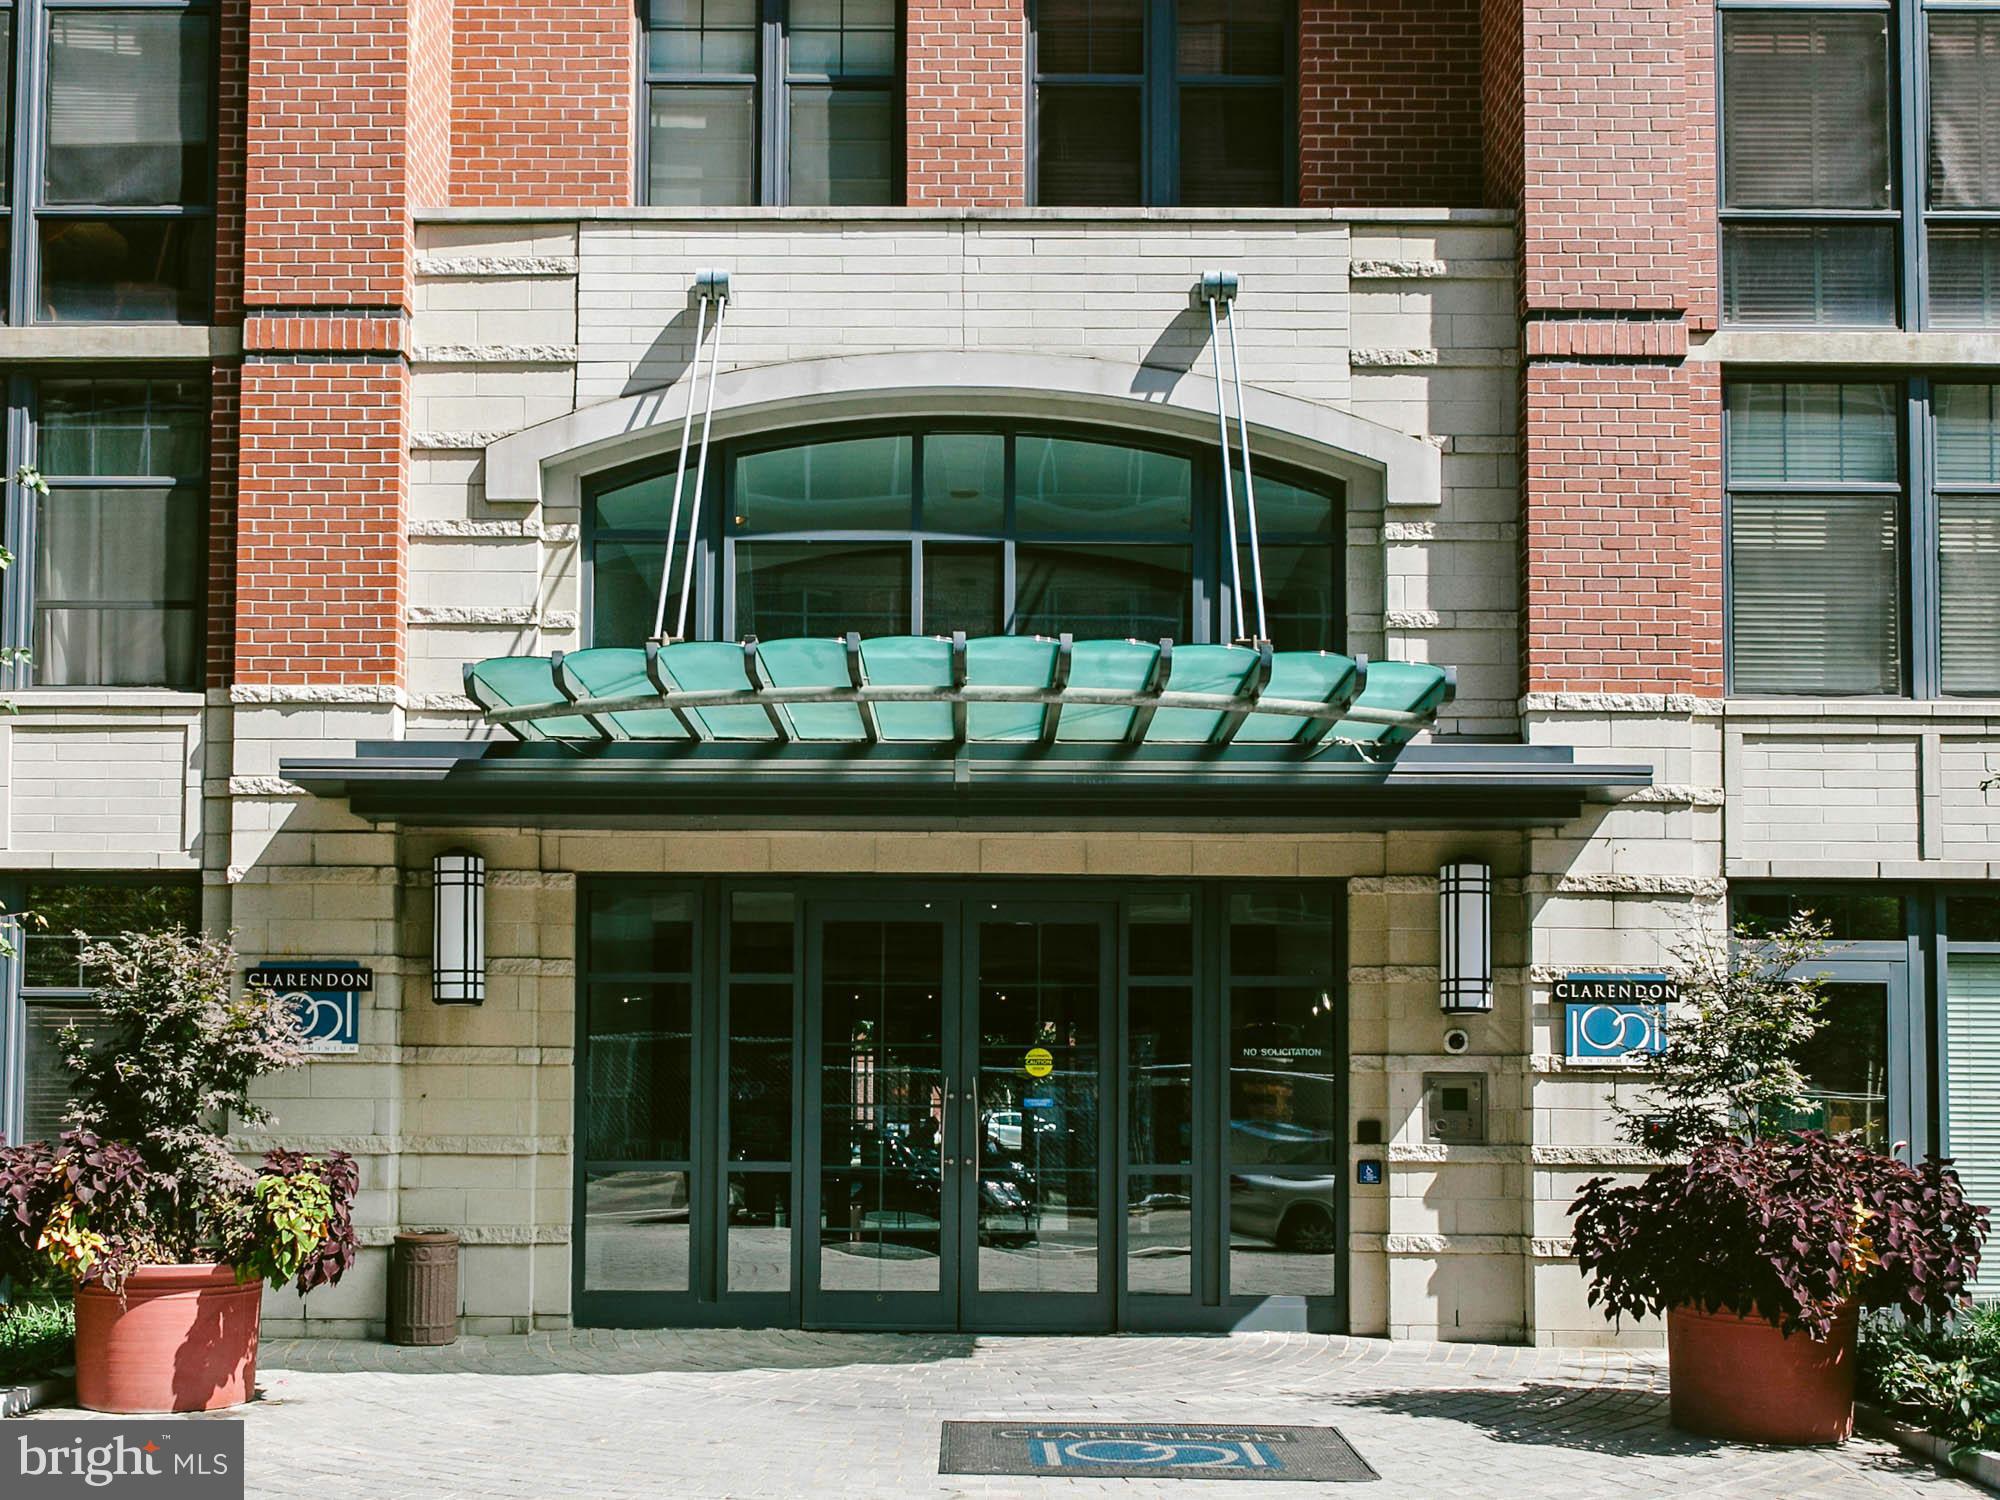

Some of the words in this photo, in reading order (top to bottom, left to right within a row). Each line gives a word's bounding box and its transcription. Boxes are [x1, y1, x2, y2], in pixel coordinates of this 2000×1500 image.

[248, 973, 369, 987] CLARENDON
[1555, 983, 1678, 998] CLARENDON
[279, 990, 353, 1040] 001
[1571, 1005, 1660, 1056] 1001
[1243, 1048, 1257, 1056] NO
[1260, 1048, 1322, 1056] SOLICITATION
[1000, 1430, 1287, 1442] CLARENDON
[1043, 1442, 1268, 1469] 1001
